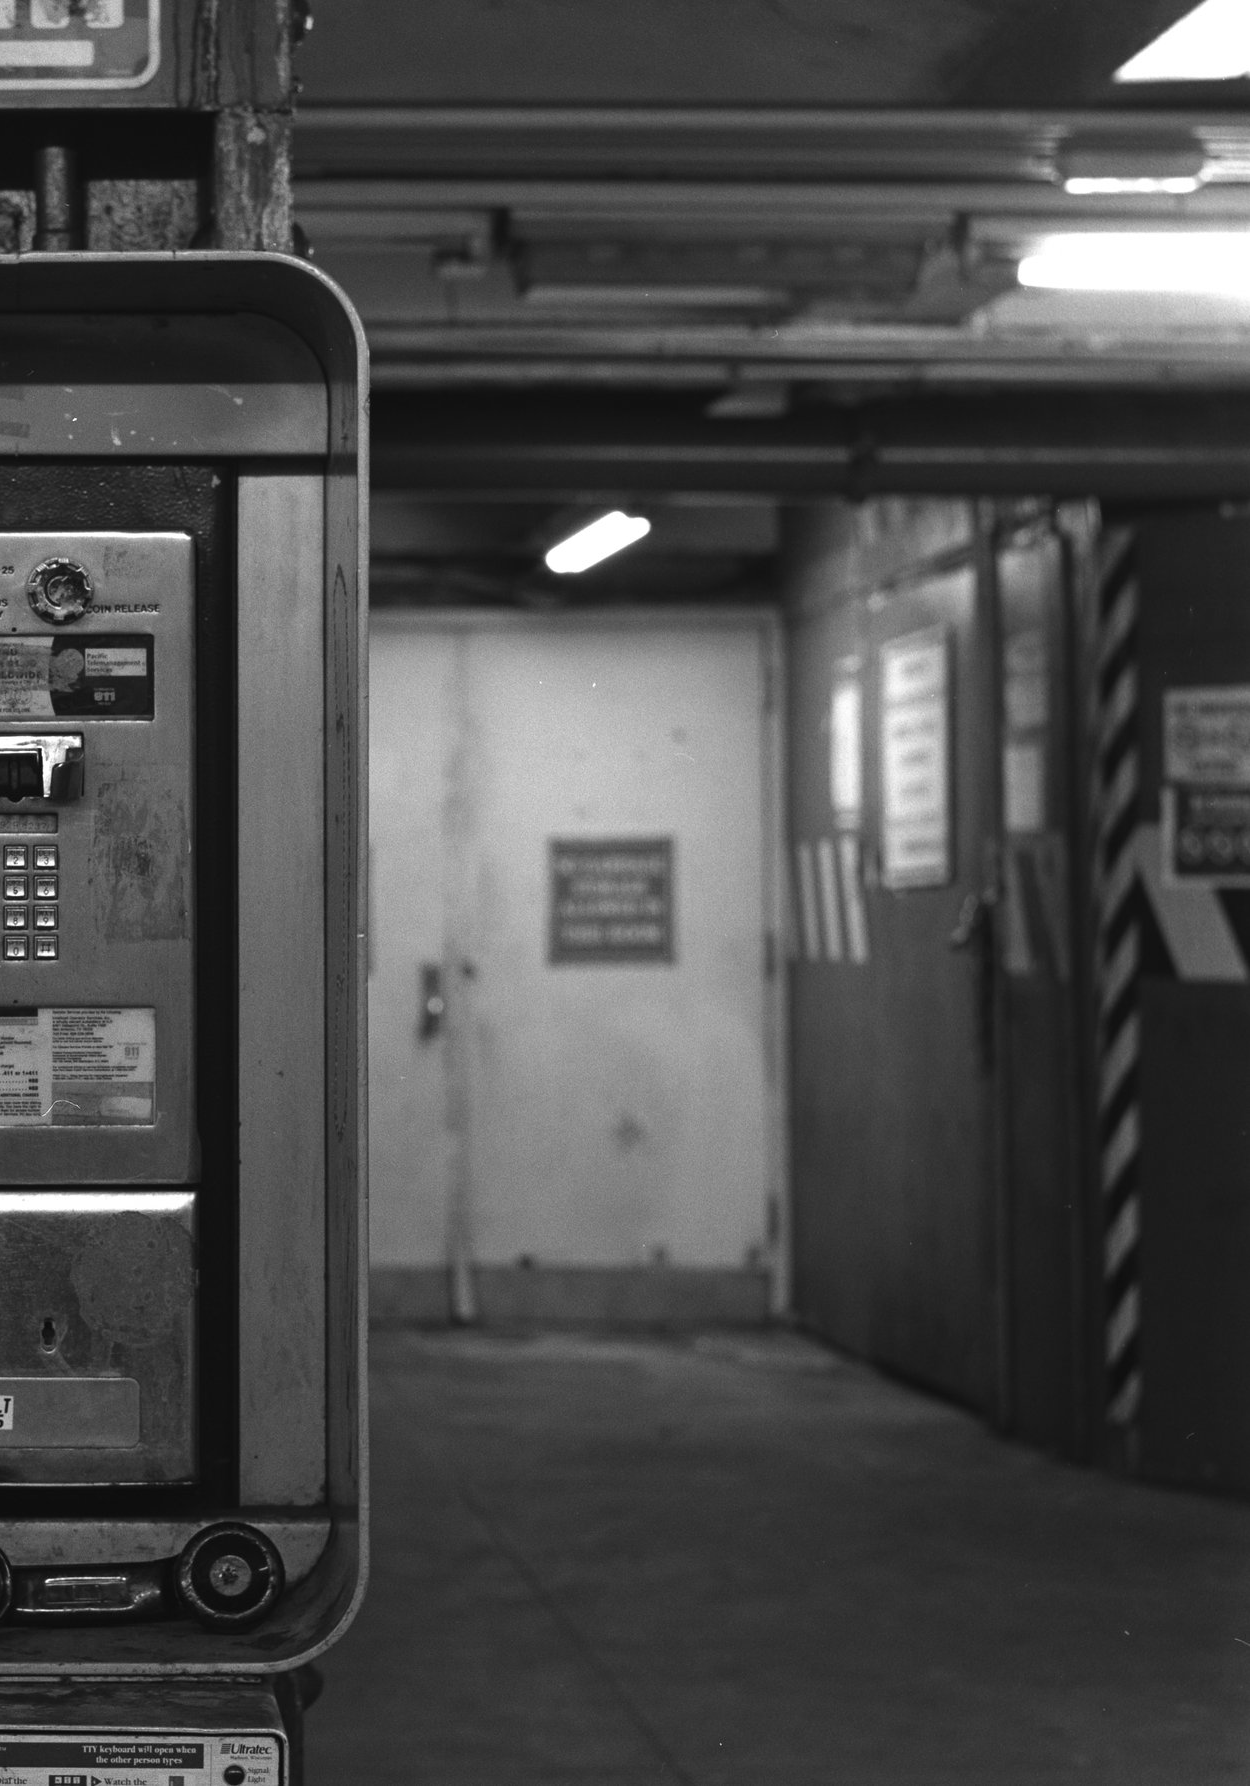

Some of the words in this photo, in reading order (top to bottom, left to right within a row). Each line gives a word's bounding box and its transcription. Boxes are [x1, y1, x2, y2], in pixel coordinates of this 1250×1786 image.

[86, 605, 111, 614] COIN
[114, 604, 160, 613] RELEASE
[13, 947, 18, 956] 0
[82, 1745, 97, 1753] TTY
[99, 1745, 136, 1756] keyboard
[137, 1745, 152, 1753] will
[154, 1747, 175, 1756] open
[231, 1743, 272, 1754] Ultratec
[96, 1756, 109, 1764] the
[110, 1756, 132, 1764] other
[247, 1767, 269, 1775] Signal
[14, 1776, 28, 1784] the
[104, 1777, 132, 1785] Watch
[133, 1777, 147, 1785] the
[248, 1775, 266, 1783] Light
